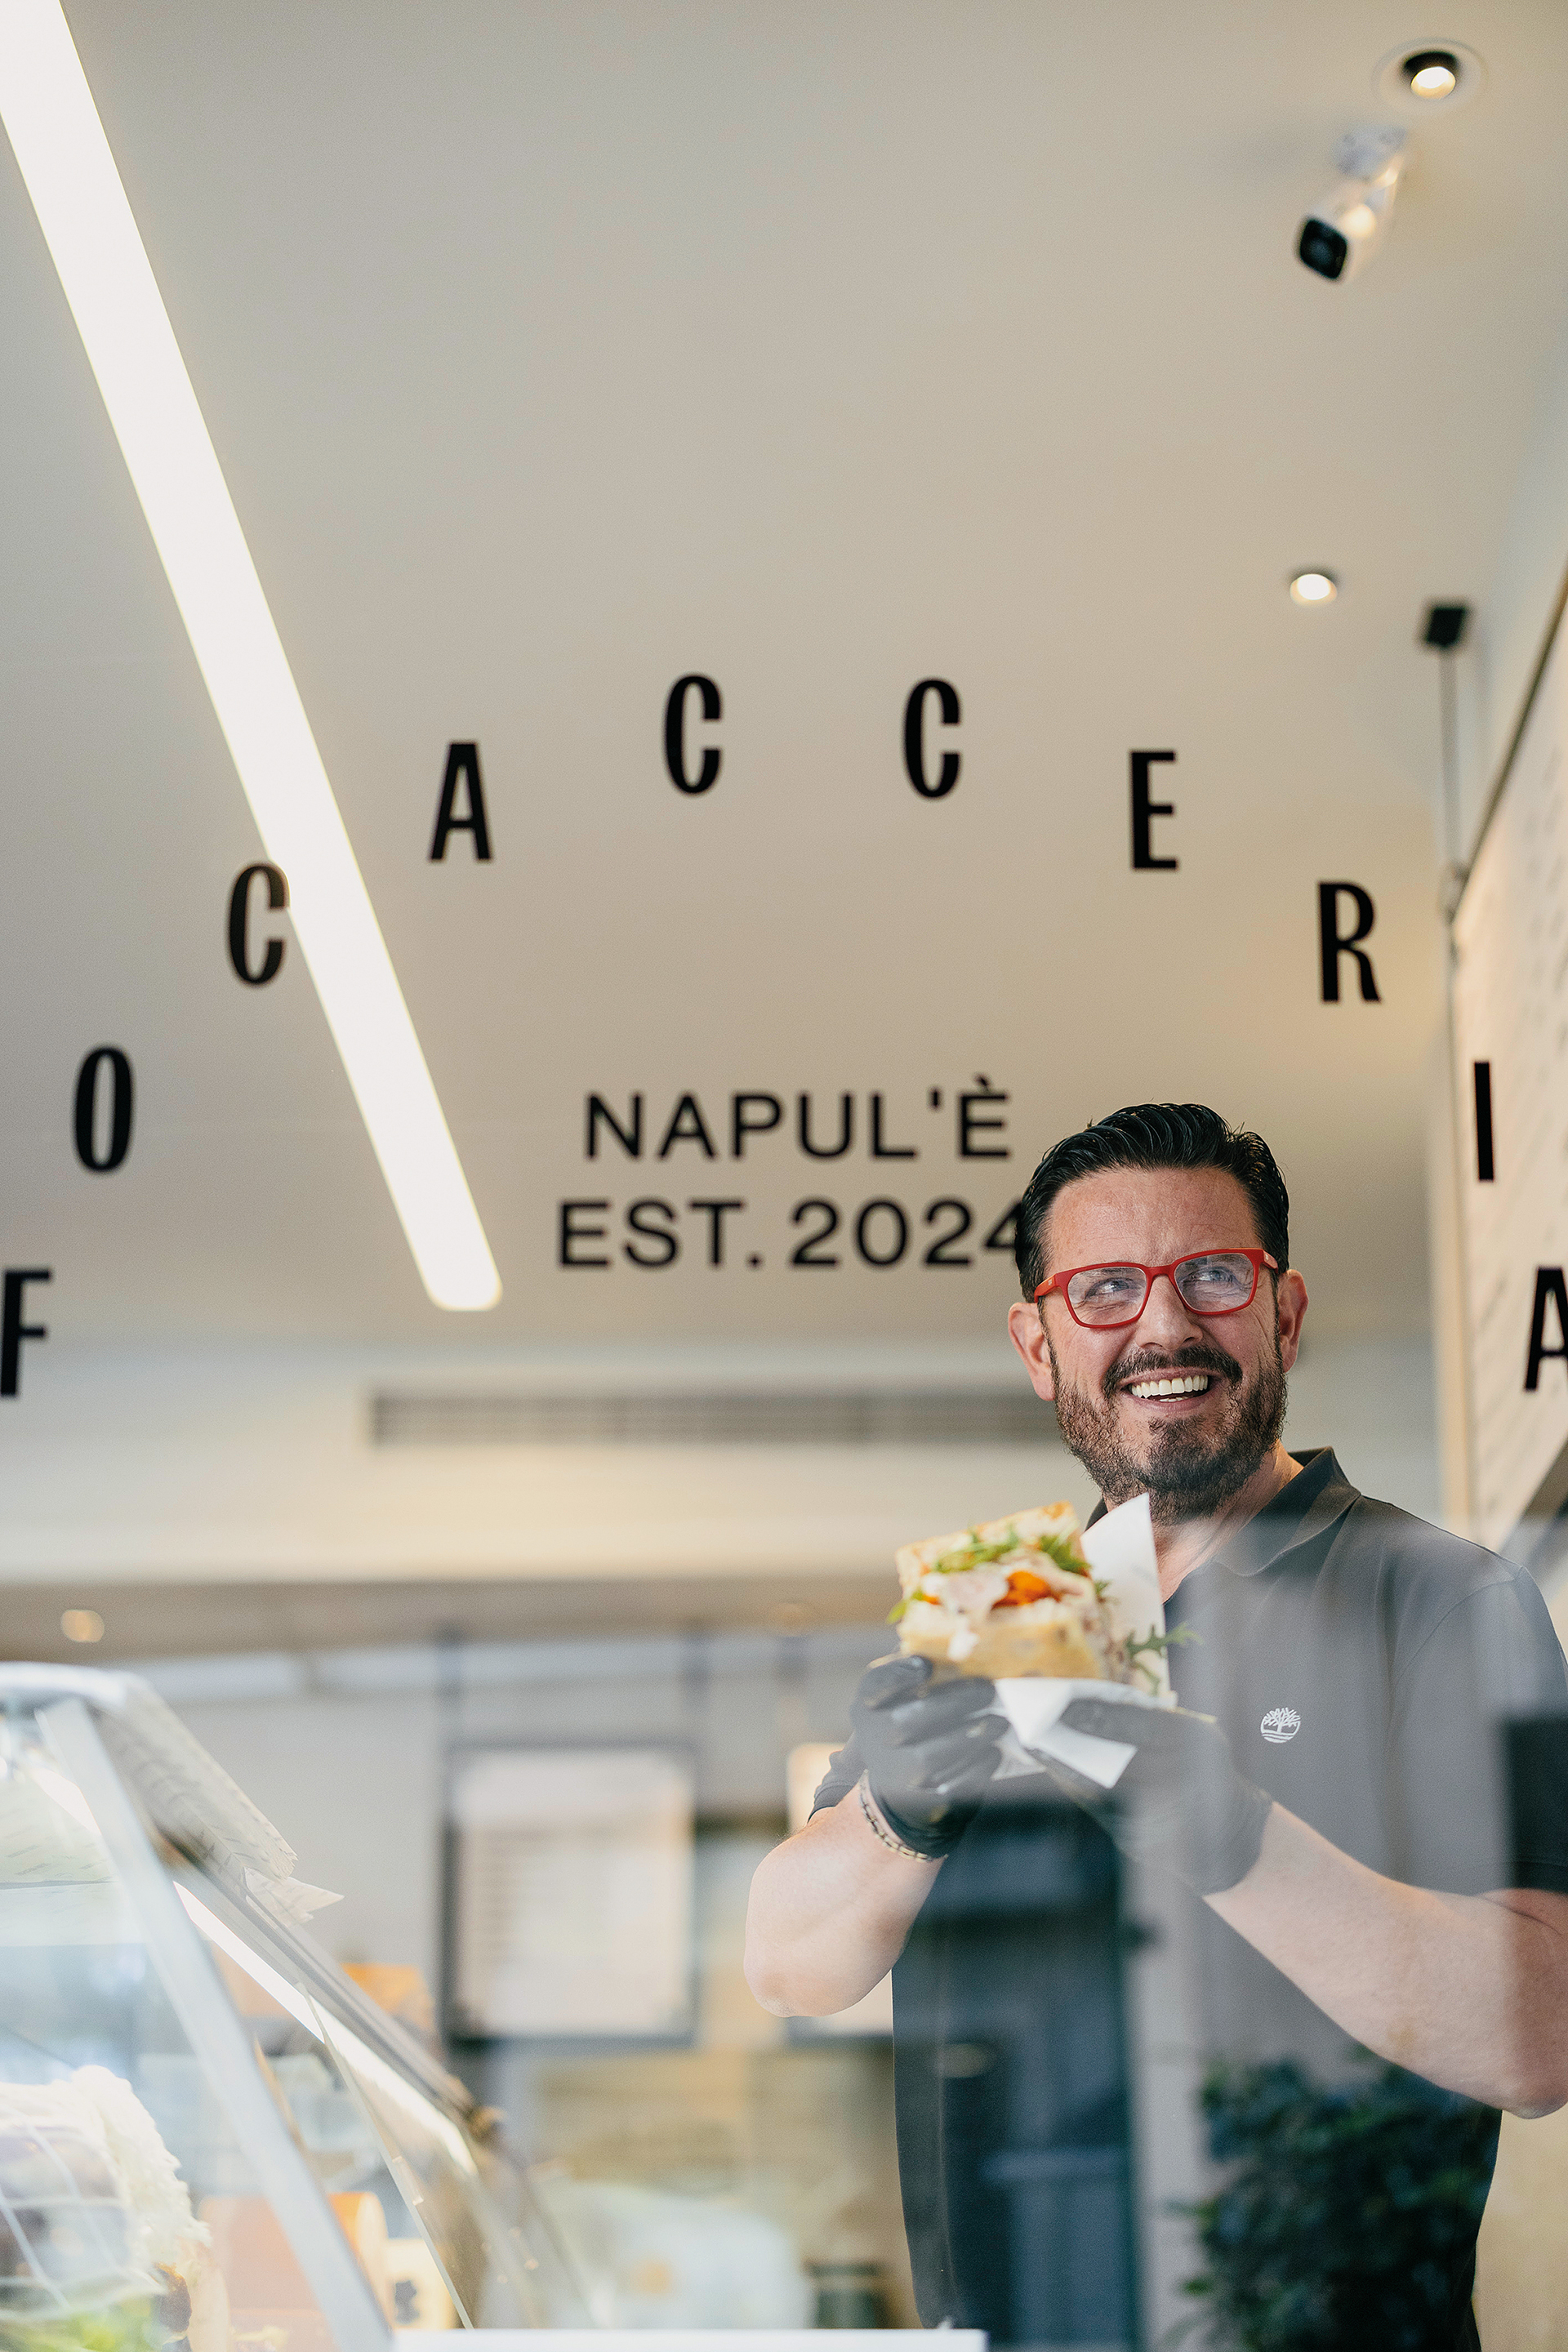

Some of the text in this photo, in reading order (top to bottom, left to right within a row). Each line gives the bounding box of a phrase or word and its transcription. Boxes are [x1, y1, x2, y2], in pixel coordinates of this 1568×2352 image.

[0, 673, 1568, 1398] FOCACCERIA
[584, 1075, 1011, 1160] NAPUL'È
[558, 1198, 761, 1269] EST.
